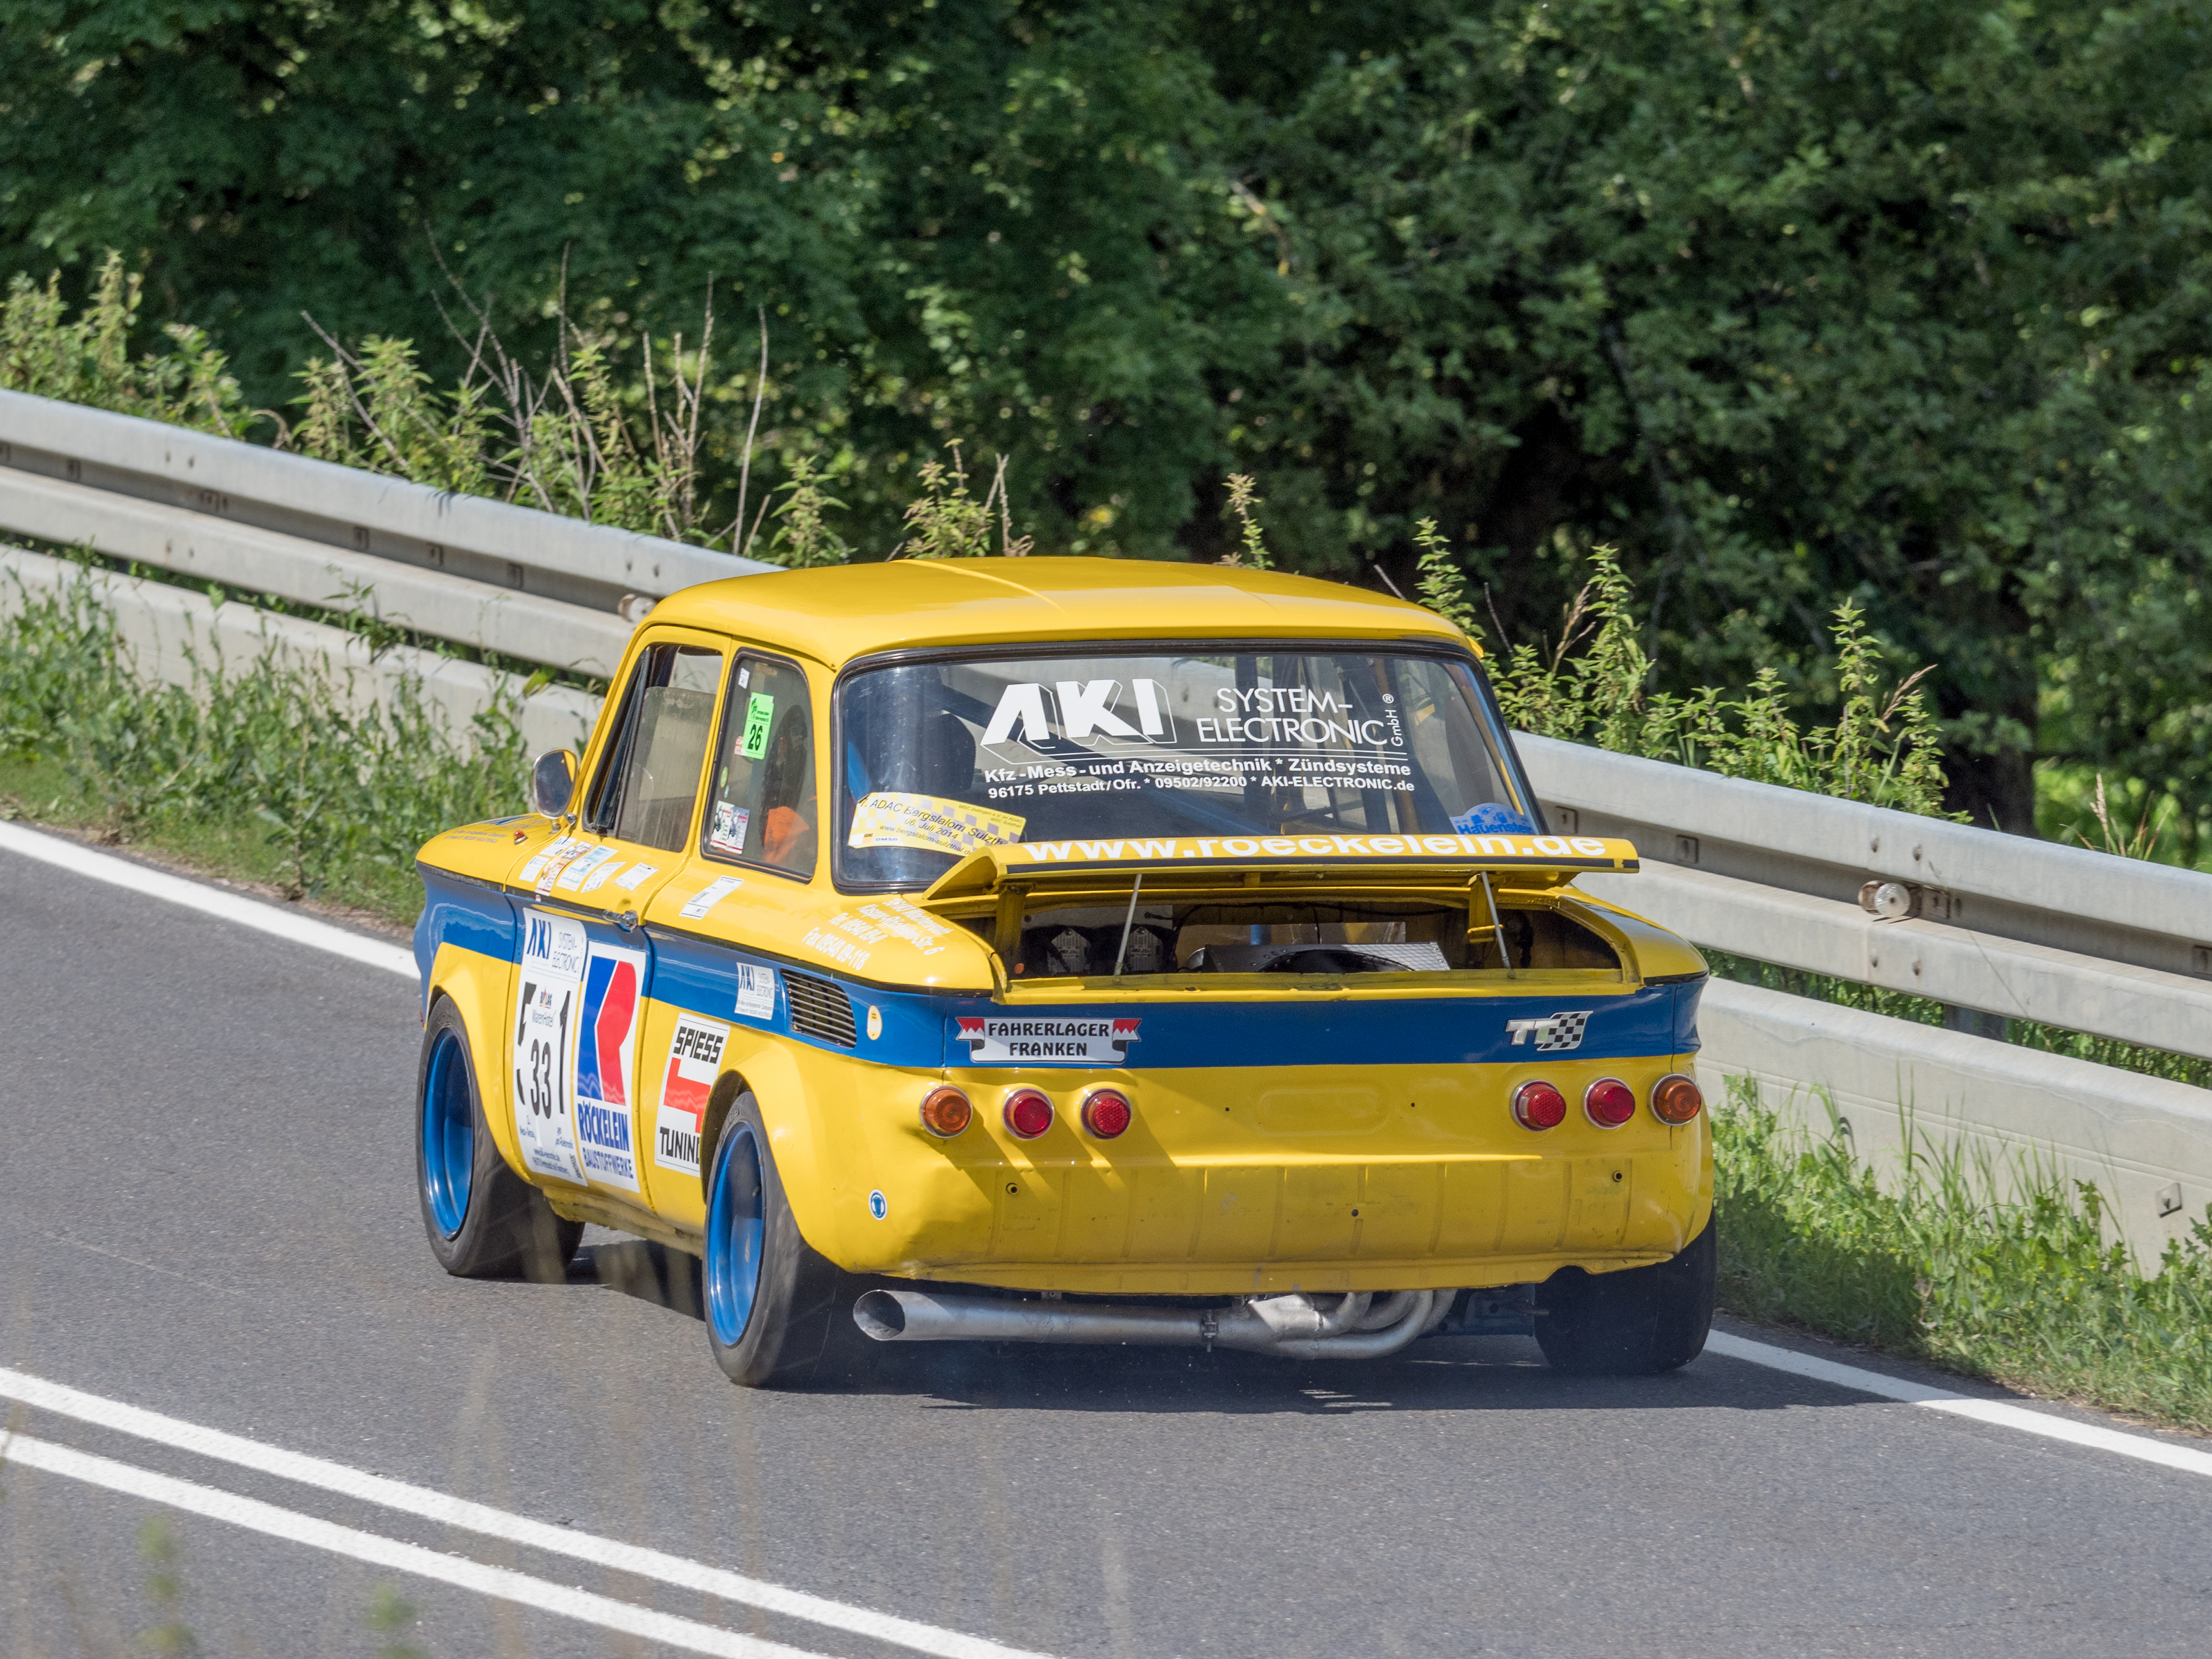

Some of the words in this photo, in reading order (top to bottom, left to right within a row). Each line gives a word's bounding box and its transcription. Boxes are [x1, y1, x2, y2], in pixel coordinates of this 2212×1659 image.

[980, 679, 1176, 749] AKI
[1216, 687, 1353, 714] SYSTEM-
[748, 724, 763, 751] 26
[1196, 717, 1388, 745] ELECTRONIC
[1387, 710, 1403, 747] GmbH
[1129, 758, 1273, 776] Anzeigetechnik
[1288, 758, 1411, 776] Zündsysteme
[988, 784, 1034, 799] 96175
[1155, 776, 1248, 789] 09502/92200
[1261, 776, 1415, 791] AKI-ELECTRONIC.de
[870, 799, 903, 812] ADAC
[903, 806, 966, 832] Bergslalom
[968, 828, 1003, 845] Sulzth
[904, 818, 917, 827] 06.
[918, 823, 937, 833] Juli
[936, 827, 959, 839] 2014
[1022, 835, 1606, 861] www.roeckelein.de
[801, 927, 823, 947] Fax
[923, 946, 945, 955] 6
[988, 1023, 1109, 1037] FAHRERLAGER
[674, 1026, 724, 1064] SPIESS
[1009, 1042, 1087, 1056] FRANKEN
[531, 1039, 551, 1119] 33
[577, 1101, 630, 1151] RÖCKELEIN
